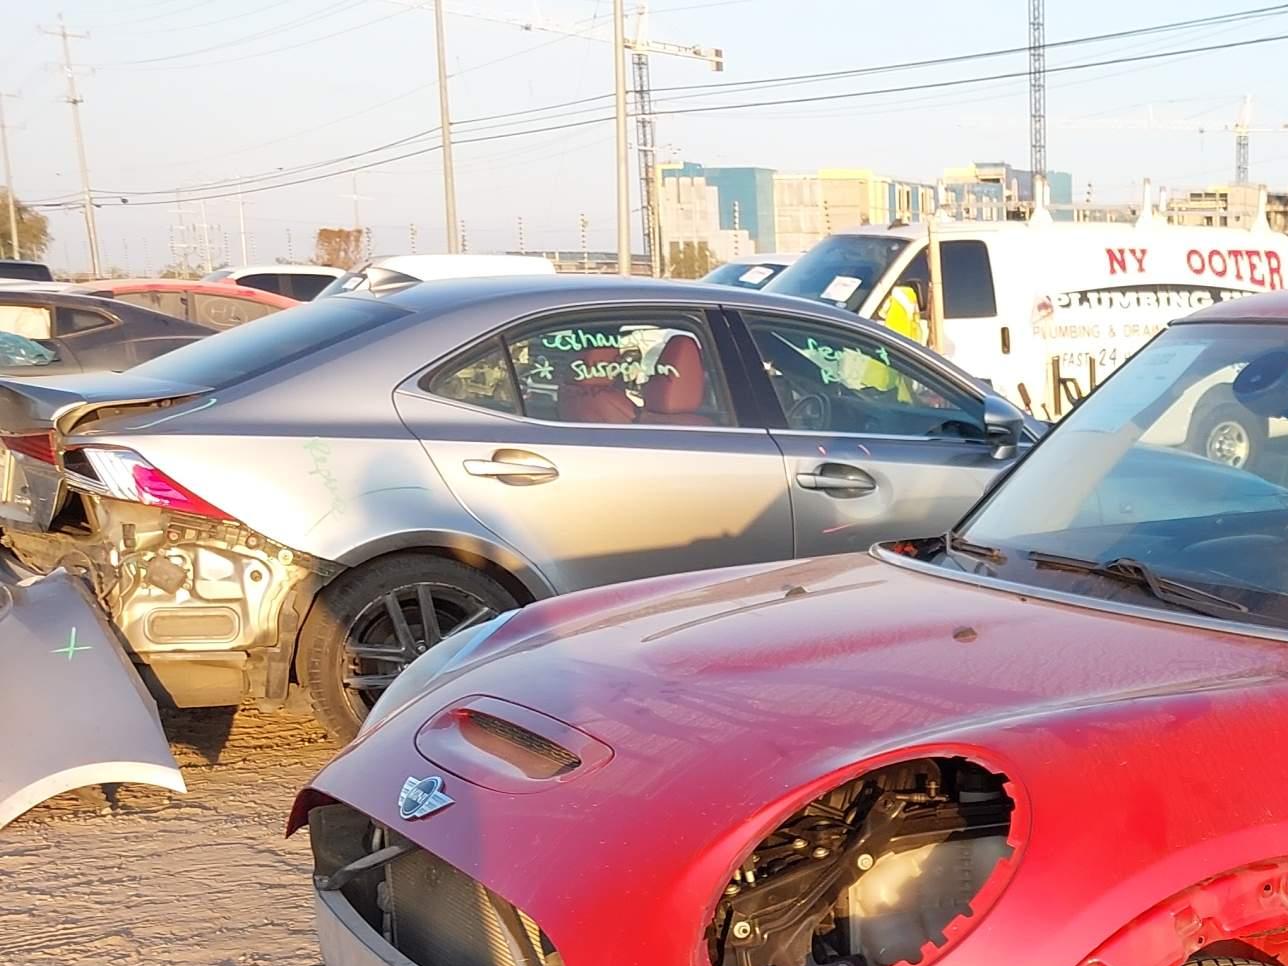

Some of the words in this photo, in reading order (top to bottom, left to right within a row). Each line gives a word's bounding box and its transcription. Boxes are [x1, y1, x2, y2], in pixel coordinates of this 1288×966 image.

[1105, 248, 1148, 275] NY
[1054, 291, 1214, 309] PLUMBING
[1099, 348, 1117, 367] 24
